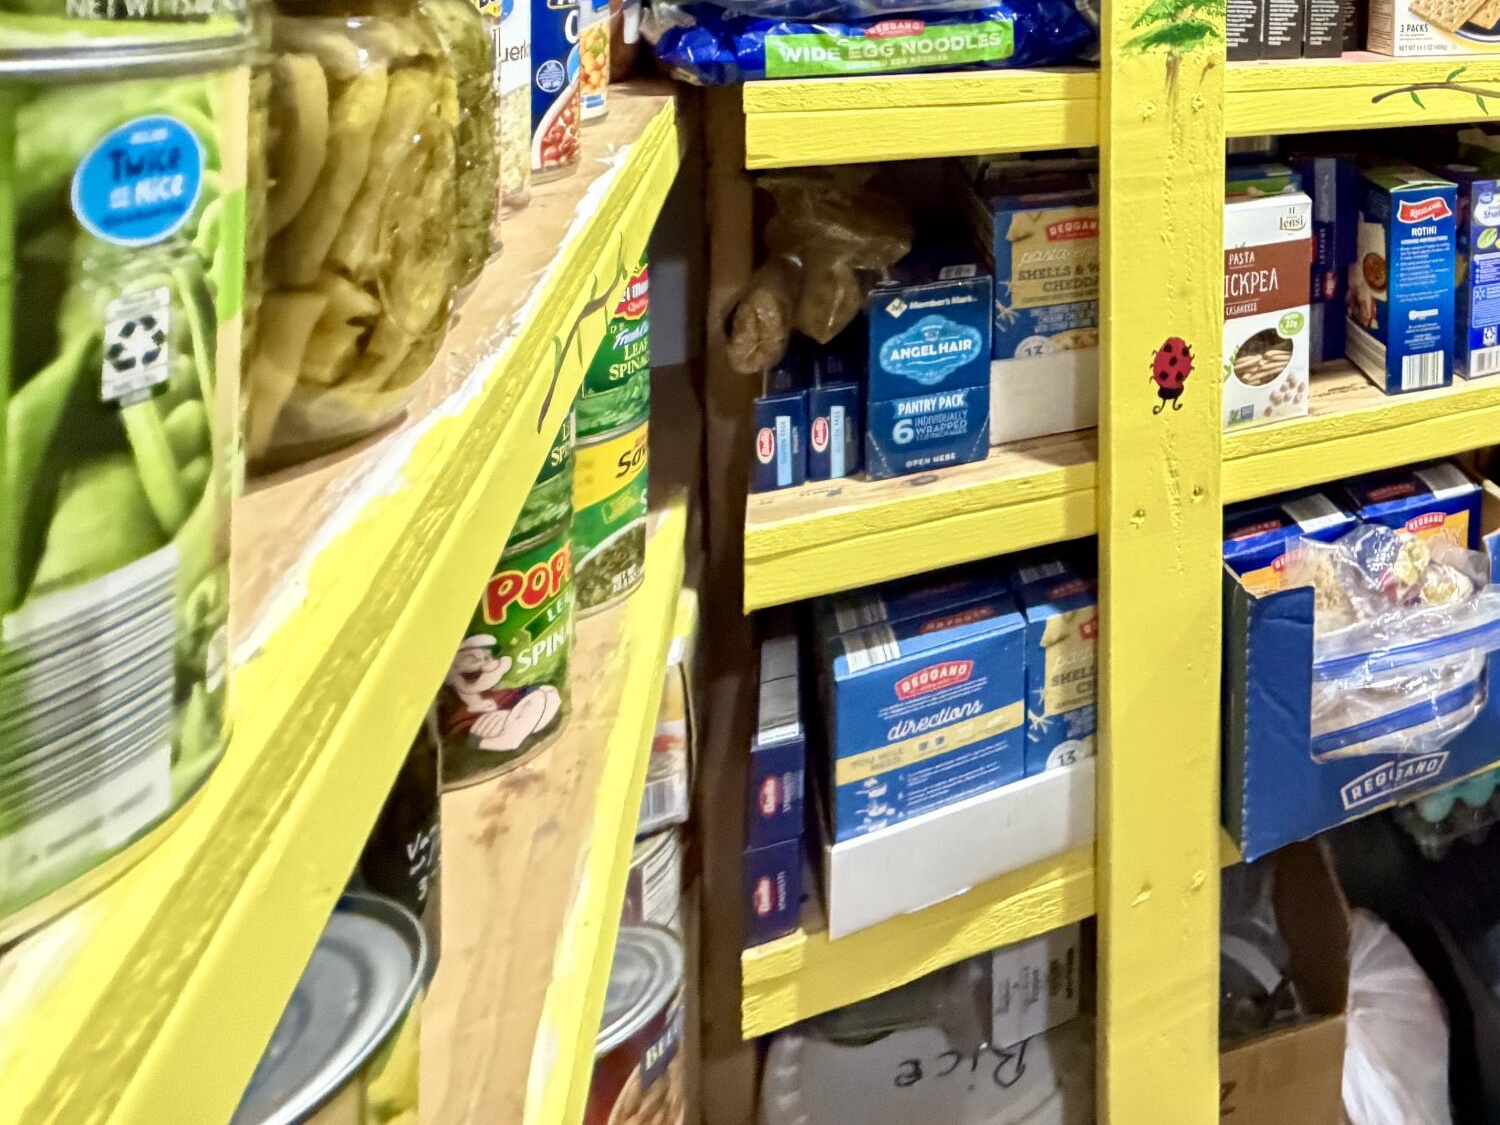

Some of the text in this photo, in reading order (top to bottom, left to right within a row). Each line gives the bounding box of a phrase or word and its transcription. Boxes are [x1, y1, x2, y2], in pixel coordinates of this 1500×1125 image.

[1406, 23, 1429, 34] PACKS
[779, 32, 1003, 65] WIDE EGG NOODLES
[1049, 220, 1099, 236] REGGAN
[1411, 226, 1438, 237] ROTINI
[1229, 250, 1256, 267] PASTA
[1018, 265, 1072, 282] SHELLS
[1042, 276, 1099, 293] CHEDDA
[1225, 267, 1280, 299] ICKPEA
[890, 338, 973, 362] ANGEL HAIR
[898, 391, 965, 417] PANTRY PACK
[914, 409, 968, 428] INDIVIDUALLY
[915, 419, 968, 436] WRAPPED
[892, 418, 915, 445] 6
[484, 539, 573, 626] POP
[516, 630, 568, 675] SPIN
[900, 664, 969, 694] REGGANO
[887, 698, 984, 742] directions
